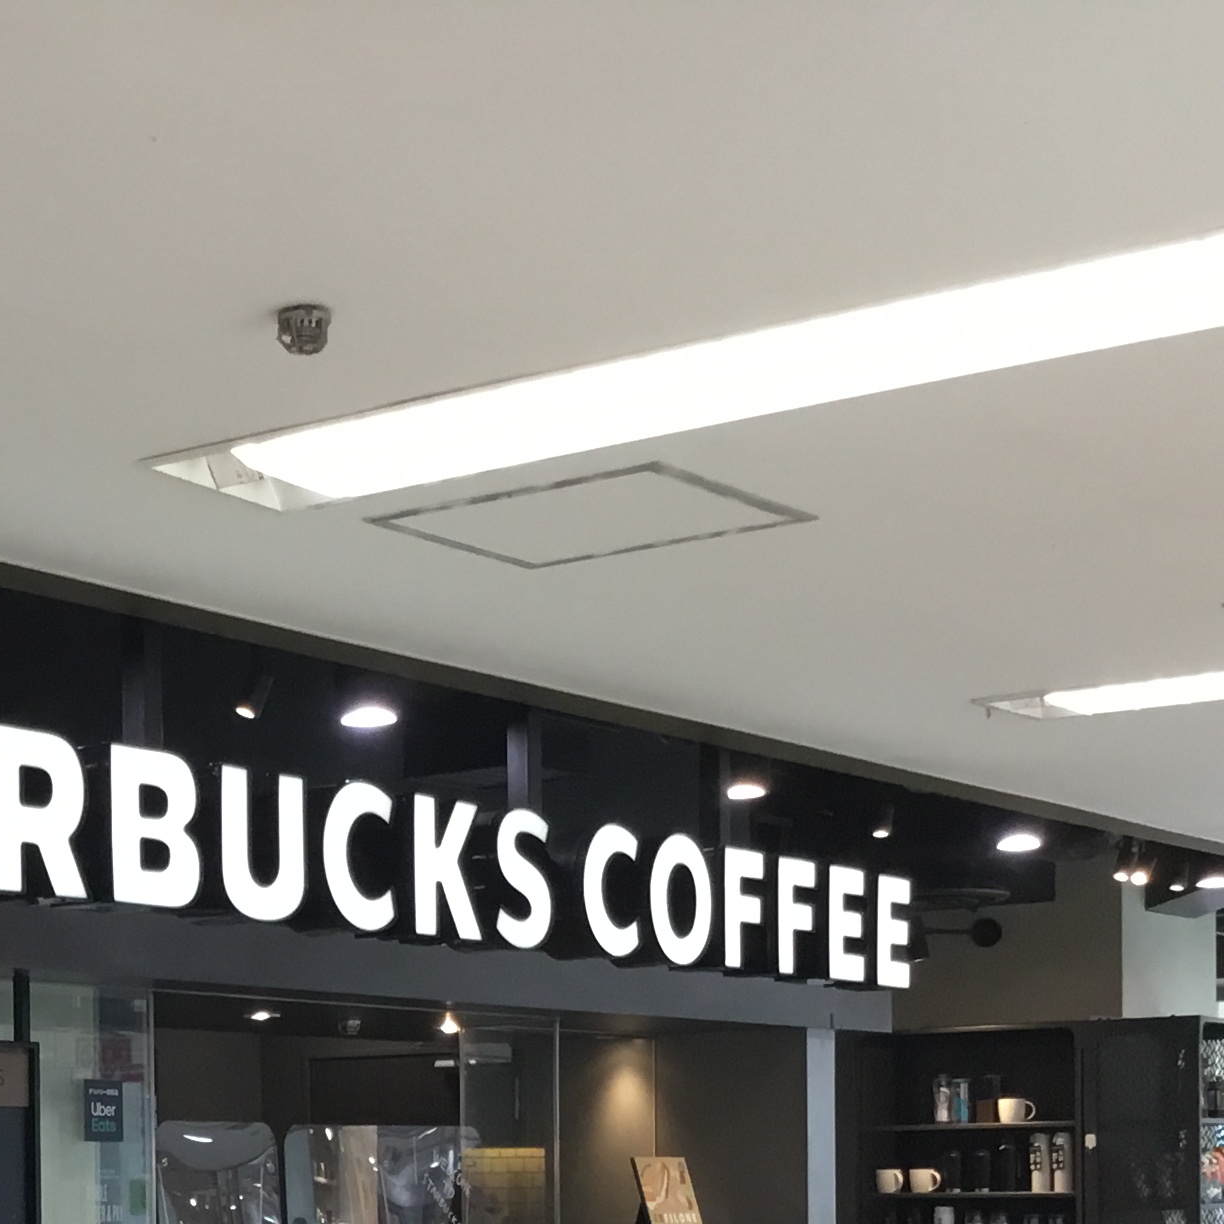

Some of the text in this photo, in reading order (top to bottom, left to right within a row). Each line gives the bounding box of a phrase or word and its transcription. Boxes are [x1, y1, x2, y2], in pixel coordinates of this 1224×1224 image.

[583, 823, 912, 989] COFFEE
[90, 1101, 117, 1117] Uber
[91, 1117, 117, 1133] Eats
